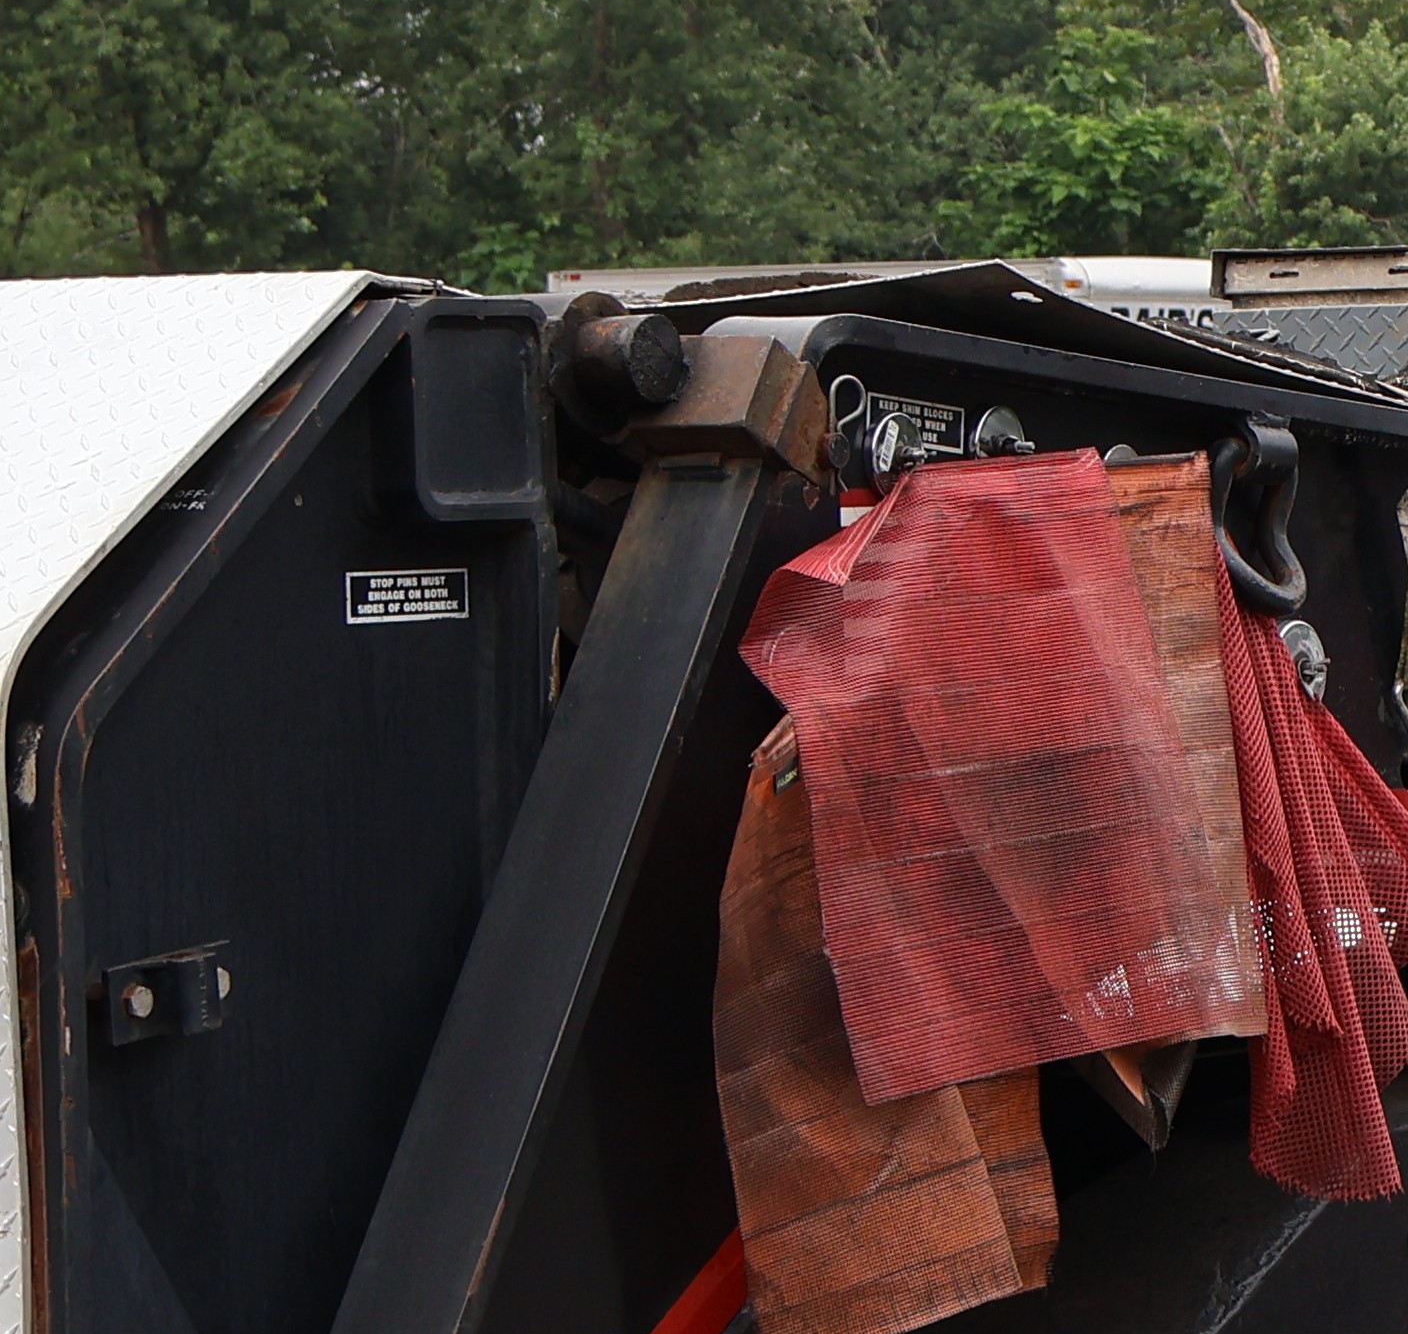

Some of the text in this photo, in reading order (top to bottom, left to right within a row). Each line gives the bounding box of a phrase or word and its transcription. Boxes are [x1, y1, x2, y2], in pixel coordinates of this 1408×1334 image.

[878, 399, 954, 421] KEEP SHIM BLOCKS
[925, 419, 947, 432] WHEN
[922, 432, 938, 443] USE
[370, 576, 446, 589] STOP PINS MUST
[368, 588, 449, 602] ENGAGE ON BOTH
[357, 600, 459, 615] SIDES OF GOOSENECK
